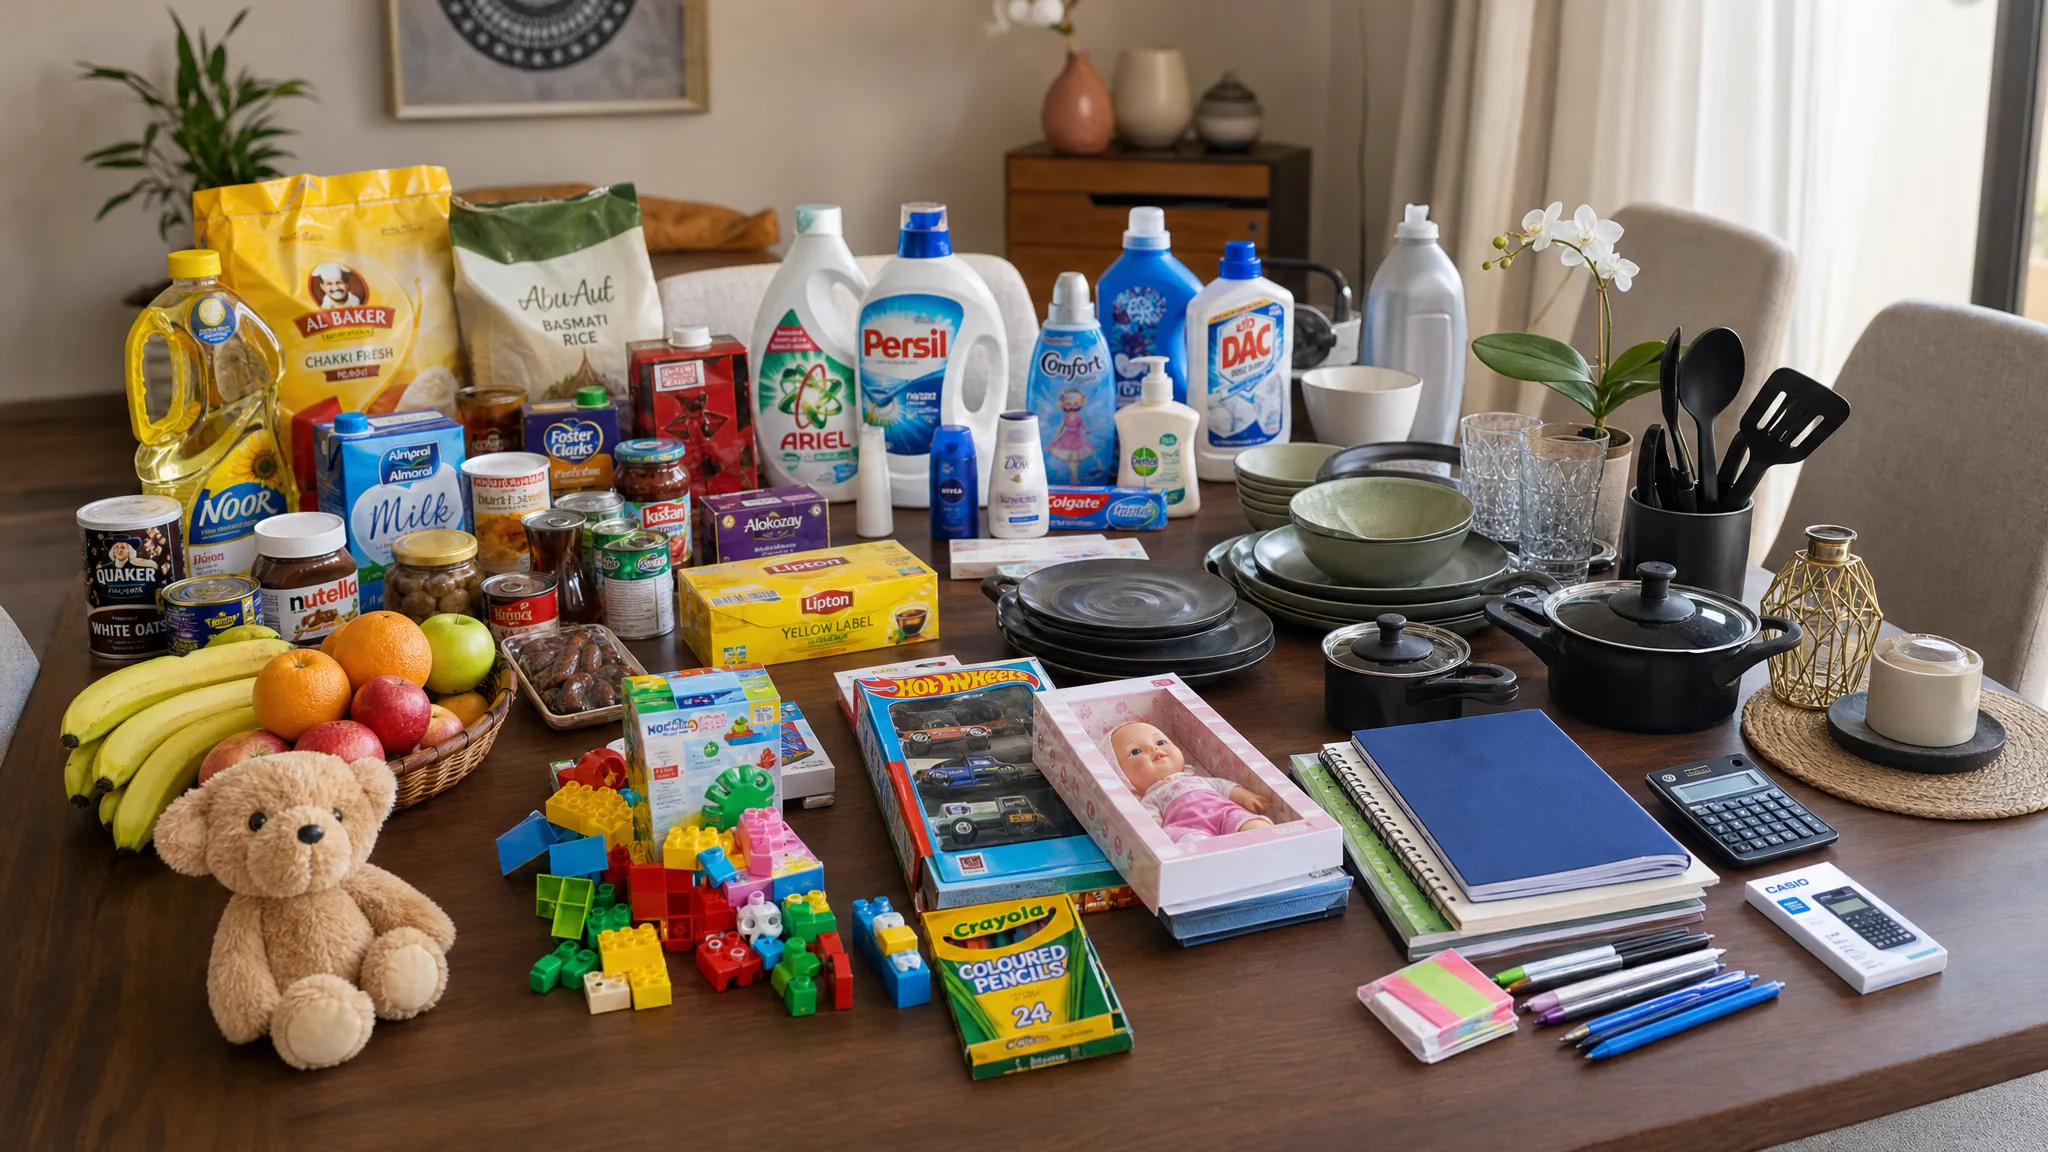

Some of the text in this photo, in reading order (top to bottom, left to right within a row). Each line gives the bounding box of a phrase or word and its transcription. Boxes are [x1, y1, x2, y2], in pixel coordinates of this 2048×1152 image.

[306, 309, 387, 332] AL BAKER
[542, 314, 608, 331] BASMATI
[563, 331, 598, 346] RICE
[864, 328, 947, 359] Persil
[1222, 323, 1271, 369] DAC
[305, 348, 394, 369] CHAKKI FRESH
[1040, 351, 1103, 382] Comfort
[551, 430, 594, 444] Foster
[780, 431, 851, 450] ARIEL
[552, 442, 594, 457] Clarks
[199, 490, 278, 527] NOOR
[1048, 495, 1100, 511] Colgate
[369, 492, 455, 540] Milk
[743, 515, 803, 533] Alokozay
[96, 567, 156, 585] QUAKER
[290, 578, 358, 612] nutella
[805, 594, 850, 614] Lipton
[92, 620, 167, 637] WHITE OATS
[781, 622, 832, 640] YELLOW
[836, 616, 874, 632] LABEL
[1765, 878, 1809, 893] CASIO
[953, 904, 1045, 938] Crayola
[958, 945, 1068, 980] COLOURED
[974, 961, 1067, 994] PENCILS
[1013, 1002, 1050, 1028] 24
